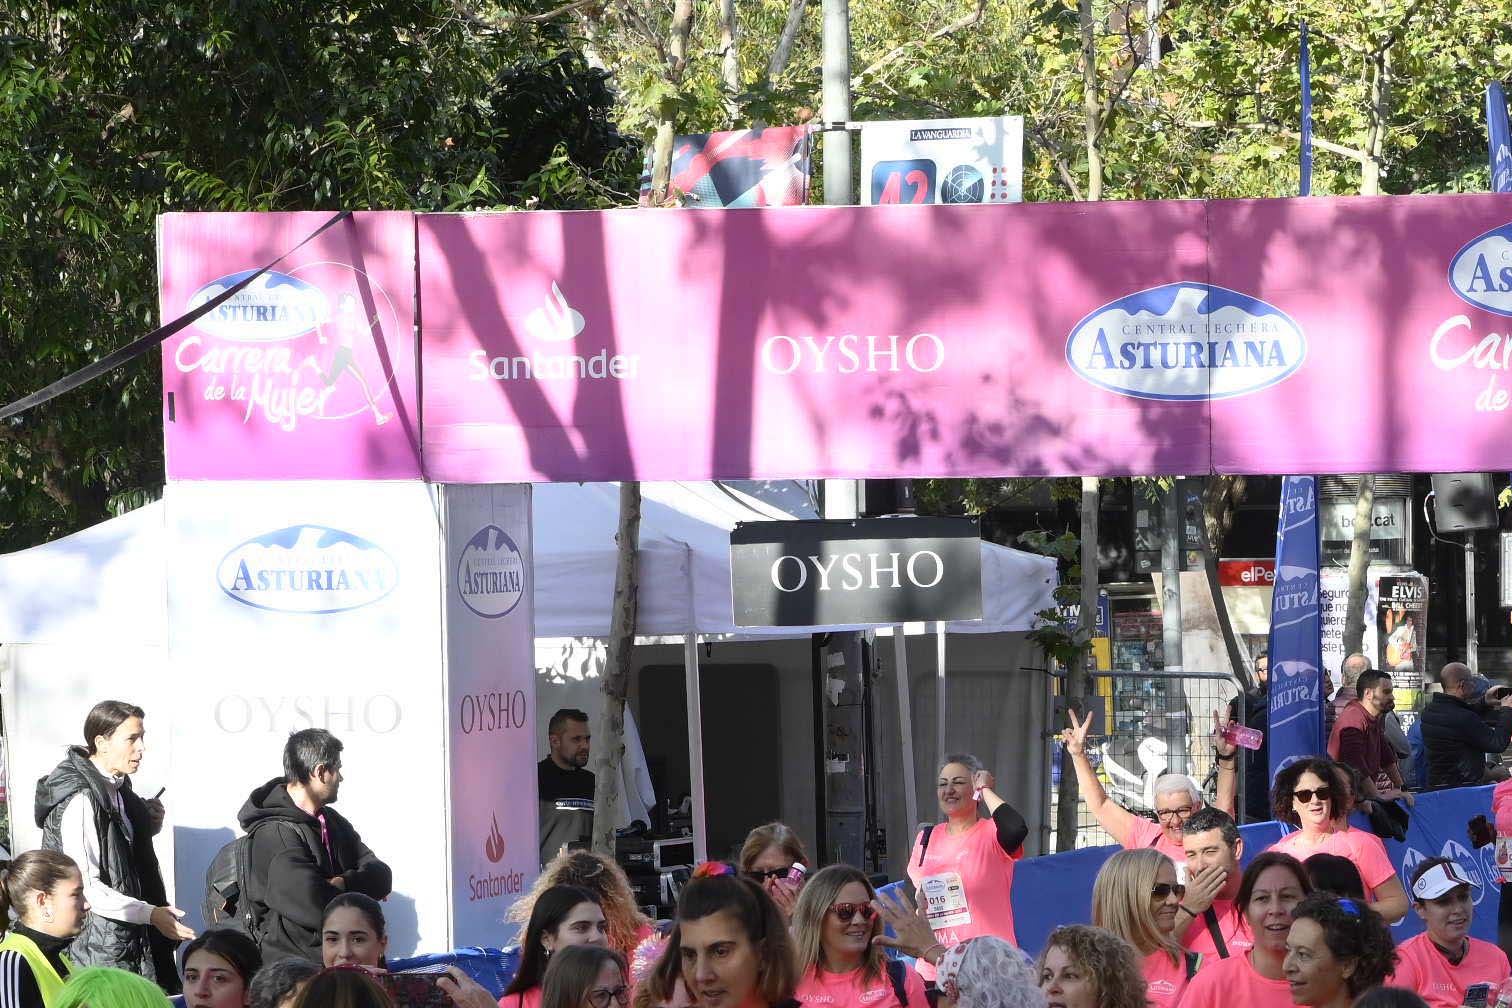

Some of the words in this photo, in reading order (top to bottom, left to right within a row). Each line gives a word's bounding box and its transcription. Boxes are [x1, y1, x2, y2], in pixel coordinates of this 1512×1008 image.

[1121, 321, 1197, 335] CENTRAL
[1205, 321, 1280, 334] LECHERA
[175, 336, 292, 373] Carrera
[469, 349, 641, 383] Santander
[762, 333, 946, 375] OYSHO
[1086, 330, 1288, 372] ASTURIANA
[204, 376, 226, 401] de
[230, 374, 245, 400] la
[242, 370, 337, 432] Mujer
[1475, 376, 1509, 411] de
[231, 558, 388, 591] ASTURIANA
[463, 560, 522, 596] ASTURIANA
[770, 549, 945, 593] OYSHO
[1391, 586, 1423, 598] ELVIS
[213, 693, 403, 735] OYSHO
[460, 689, 527, 735] OYSHO
[468, 870, 525, 903] Santander
[929, 895, 946, 905] 016
